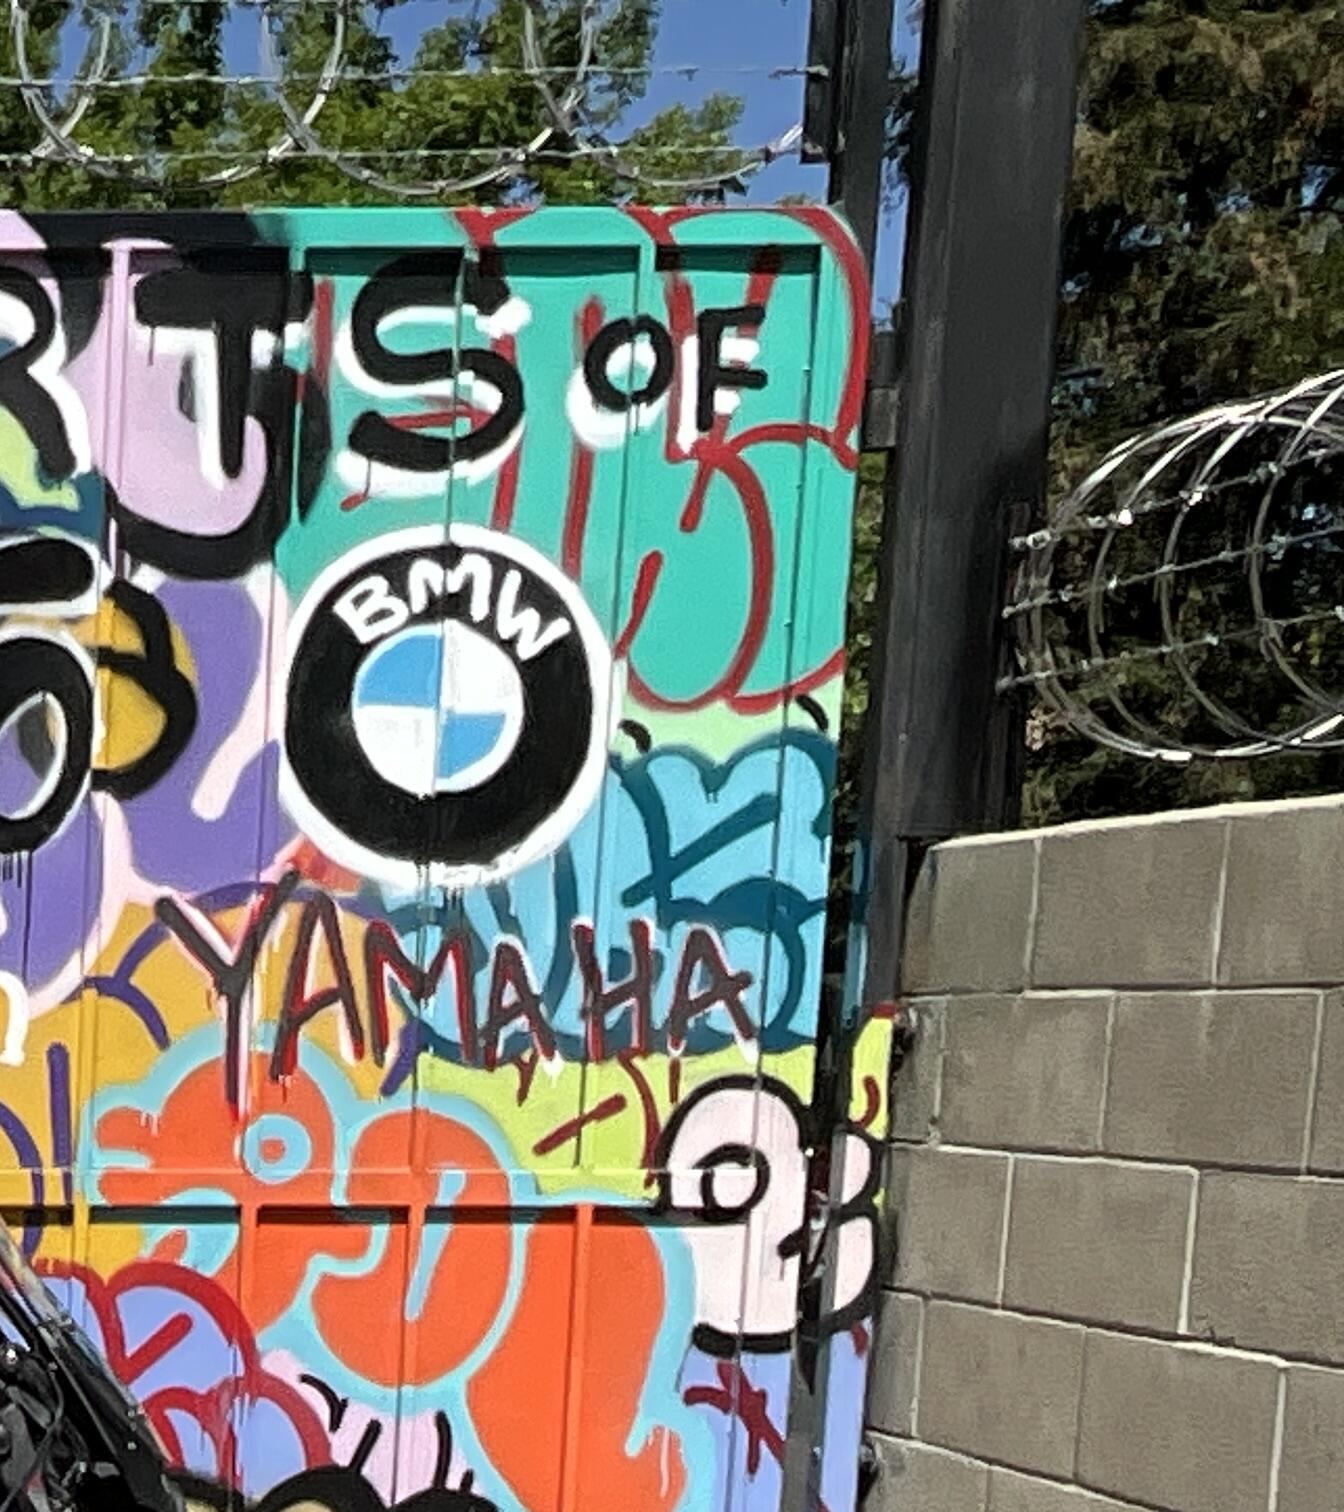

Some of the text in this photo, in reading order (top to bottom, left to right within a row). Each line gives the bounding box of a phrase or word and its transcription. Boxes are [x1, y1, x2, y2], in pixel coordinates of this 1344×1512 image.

[567, 300, 770, 455] OF
[330, 553, 574, 664] BMW
[154, 868, 762, 1125] YAMAHA
